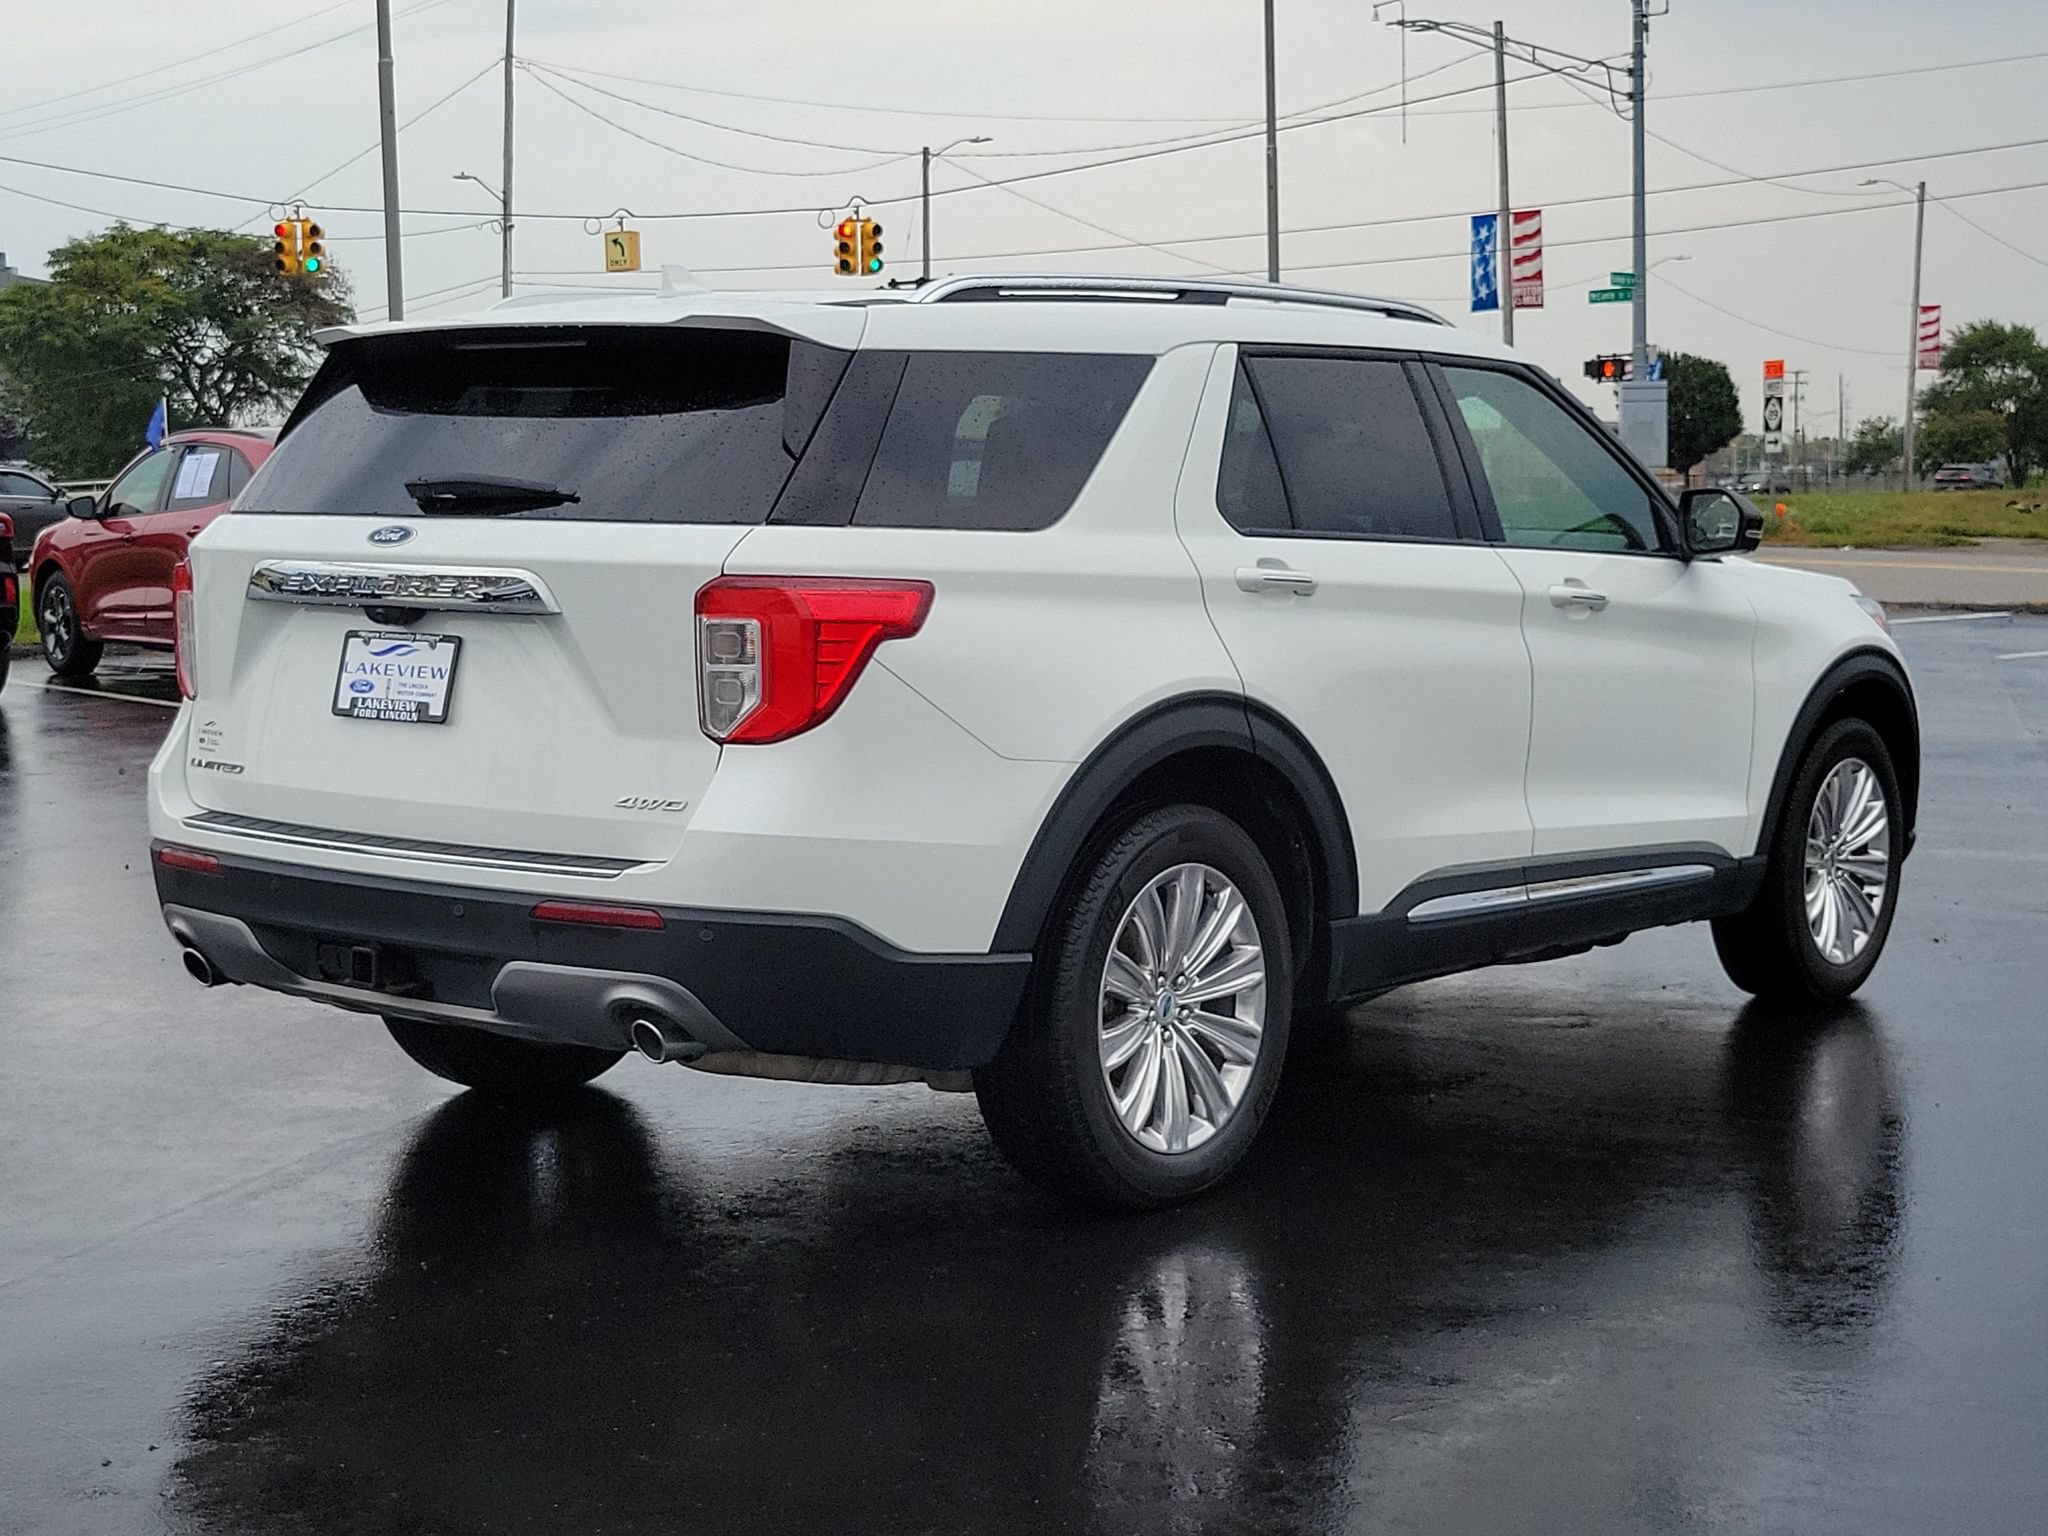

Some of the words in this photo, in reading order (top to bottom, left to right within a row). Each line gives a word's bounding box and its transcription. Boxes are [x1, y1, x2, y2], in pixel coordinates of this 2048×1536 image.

[280, 575, 485, 599] EXPLORER
[344, 661, 449, 680] LAKEVIEW
[357, 698, 419, 712] LAKEVIEW
[353, 707, 378, 719] FORD
[380, 710, 419, 722] LINCOLN
[191, 758, 245, 774] LIMITED
[613, 796, 689, 812] 4WD
